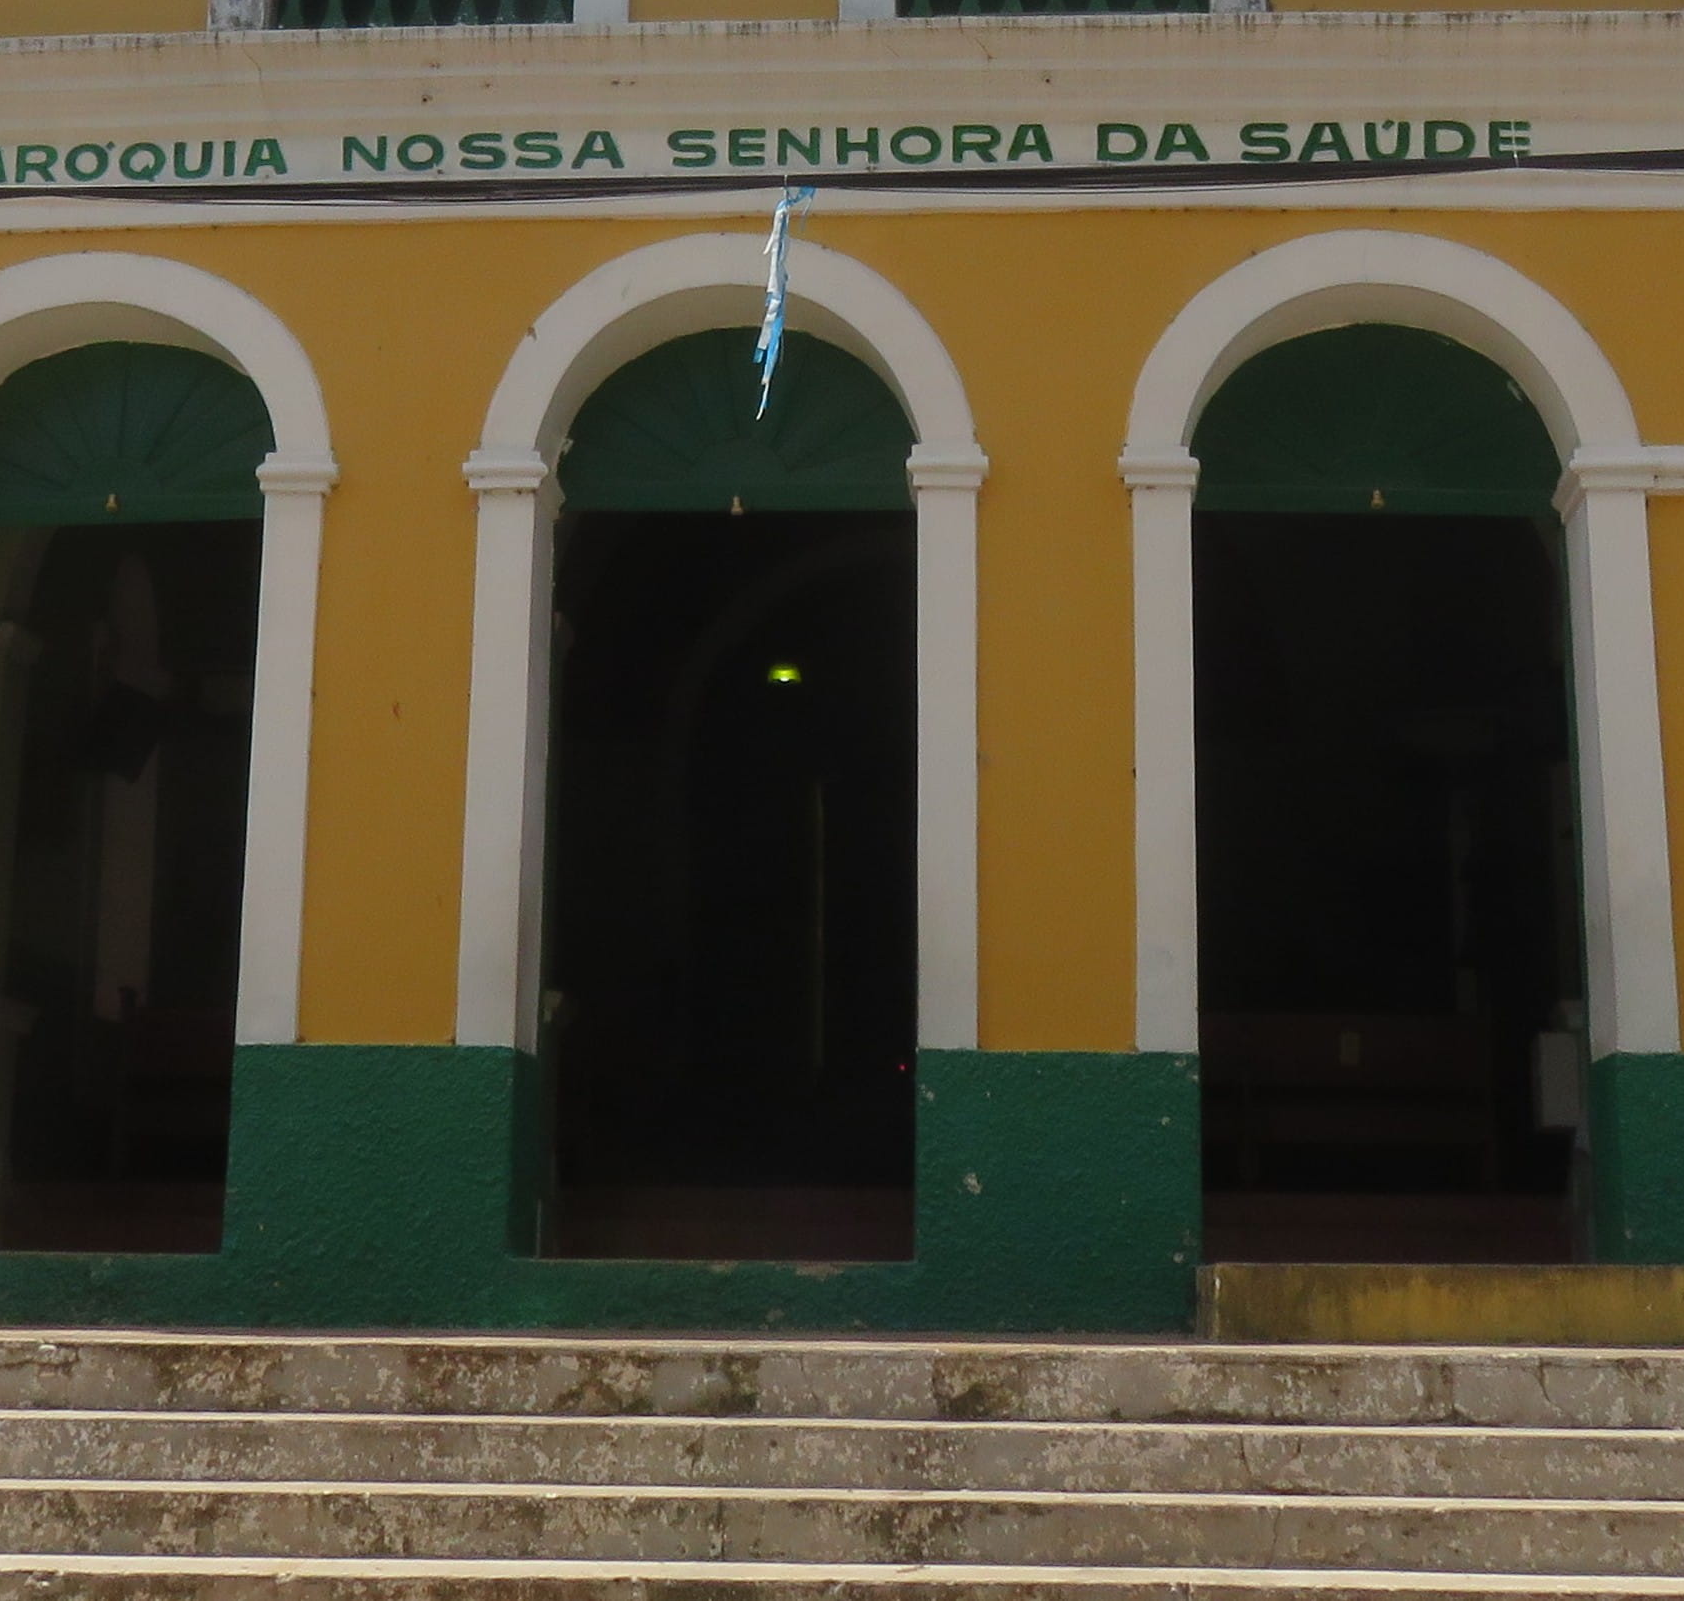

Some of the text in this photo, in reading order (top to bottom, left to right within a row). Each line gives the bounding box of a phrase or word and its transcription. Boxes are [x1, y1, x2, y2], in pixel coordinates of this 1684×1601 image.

[342, 130, 625, 172] NOSSA
[667, 124, 1054, 168] SENHORA
[1096, 122, 1211, 162] DA
[1239, 118, 1532, 162] SAÚDE
